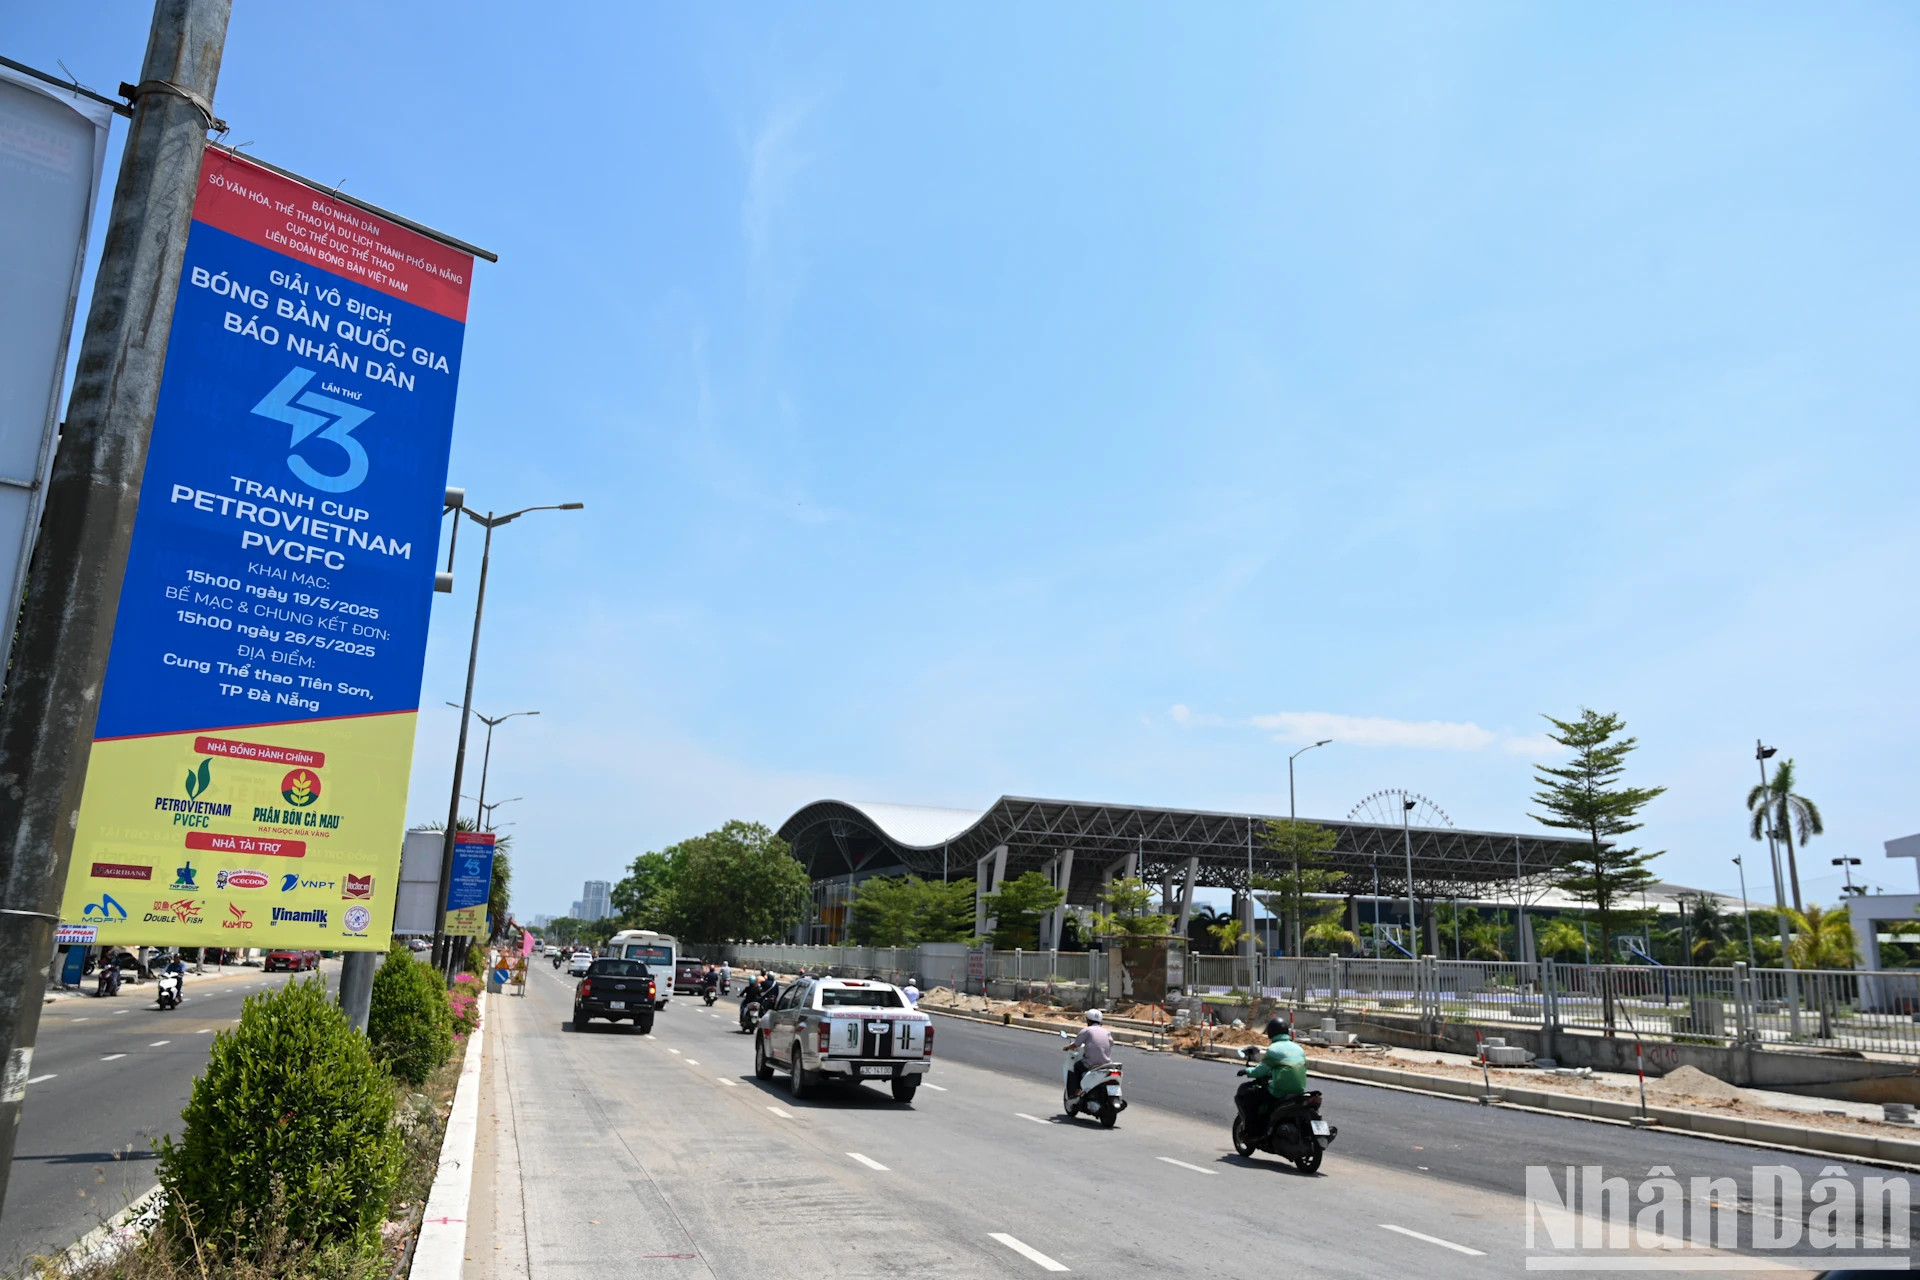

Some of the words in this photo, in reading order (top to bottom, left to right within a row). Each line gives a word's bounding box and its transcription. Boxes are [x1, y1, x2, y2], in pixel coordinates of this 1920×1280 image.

[209, 173, 224, 187] SỞ
[226, 181, 247, 197] VĂN
[248, 190, 272, 209] HÓA,
[274, 200, 295, 216] THỂ
[296, 210, 322, 227] THAO
[323, 220, 336, 233] VÀ
[338, 227, 351, 239] DU
[352, 232, 373, 249] LỊCH
[375, 242, 405, 261] THÀNH
[406, 255, 425, 269] PHỐ
[425, 263, 438, 275] ĐÀ
[439, 268, 463, 285] NẴNG
[312, 200, 332, 216] BÁO
[333, 209, 359, 227] NHÂN
[361, 221, 380, 236] DÂN
[265, 229, 288, 246] LIÊN
[289, 239, 317, 257] ĐOÀN
[318, 249, 345, 268] BÓNG
[346, 261, 366, 276] BÀN
[367, 268, 387, 285] VIỆT
[388, 277, 408, 292] NAM
[286, 221, 307, 237] CỤC
[308, 230, 328, 246] THỂ
[329, 239, 349, 254] DỤC
[351, 247, 369, 262] THỂ
[371, 255, 395, 272] THAO
[269, 270, 310, 296] GIẢI
[314, 285, 341, 307] VÔ
[346, 298, 393, 327] ĐỊCH
[190, 266, 269, 310] BÓNG
[276, 297, 330, 332] BÀN
[336, 319, 406, 359] QUỐC
[411, 346, 451, 375] GIA
[223, 311, 280, 346] BÁO
[286, 333, 359, 374] NHÂN
[365, 359, 416, 392] DÂN
[230, 475, 315, 511] TRANH
[321, 501, 370, 523] CUP
[170, 483, 412, 560] PETROVIETNAM
[241, 530, 345, 571] PVCFC
[248, 562, 287, 581] KHAI
[291, 571, 330, 590] MẠC:
[185, 569, 241, 591] 15h00
[246, 583, 288, 603] ngày
[292, 592, 379, 620] 19/5/2025
[165, 585, 191, 602] BẾ
[194, 592, 233, 611] MẠC
[237, 601, 249, 613] &
[253, 604, 314, 626] CHUNG
[318, 615, 348, 632] KẾT
[351, 625, 391, 641] ĐƠN:
[176, 610, 233, 631] 15h00
[237, 623, 280, 643] ngày
[284, 630, 376, 658] 26/5/2025
[237, 644, 266, 661] ĐỊA
[271, 649, 316, 669] ĐIỂM:
[163, 652, 211, 674] Cung
[216, 661, 252, 679] Thể
[254, 668, 293, 685] thao
[298, 675, 333, 692] Tiên
[337, 682, 374, 700] Sơn,
[219, 683, 243, 698] TP
[247, 687, 271, 703] Đà
[276, 691, 320, 713] Nẵng
[207, 741, 228, 753] NHÀ
[229, 743, 256, 757] ĐỒNG
[258, 748, 284, 760] HÀNH
[285, 751, 314, 764] CHÍNH
[154, 796, 232, 817] PETROVIETNAM
[173, 812, 210, 829] PVCFC
[252, 805, 280, 823] PHÂN
[282, 808, 302, 826] BÓN
[304, 810, 317, 827] CÀ
[319, 814, 341, 830] MAU
[212, 836, 236, 849] NHÀ
[238, 838, 255, 851] TÀI
[257, 841, 282, 854] TRỢ
[258, 826, 271, 834] HẠT
[272, 826, 294, 836] NGỌC
[294, 828, 309, 836] MÙA
[310, 829, 331, 838] VÀNG
[104, 868, 147, 877] AGRIBANK
[301, 880, 335, 889] VNPT
[81, 916, 127, 924] MOFIT
[186, 916, 204, 924] FISH
[222, 920, 253, 929] KAMITO
[272, 907, 327, 923] Vinamilk
